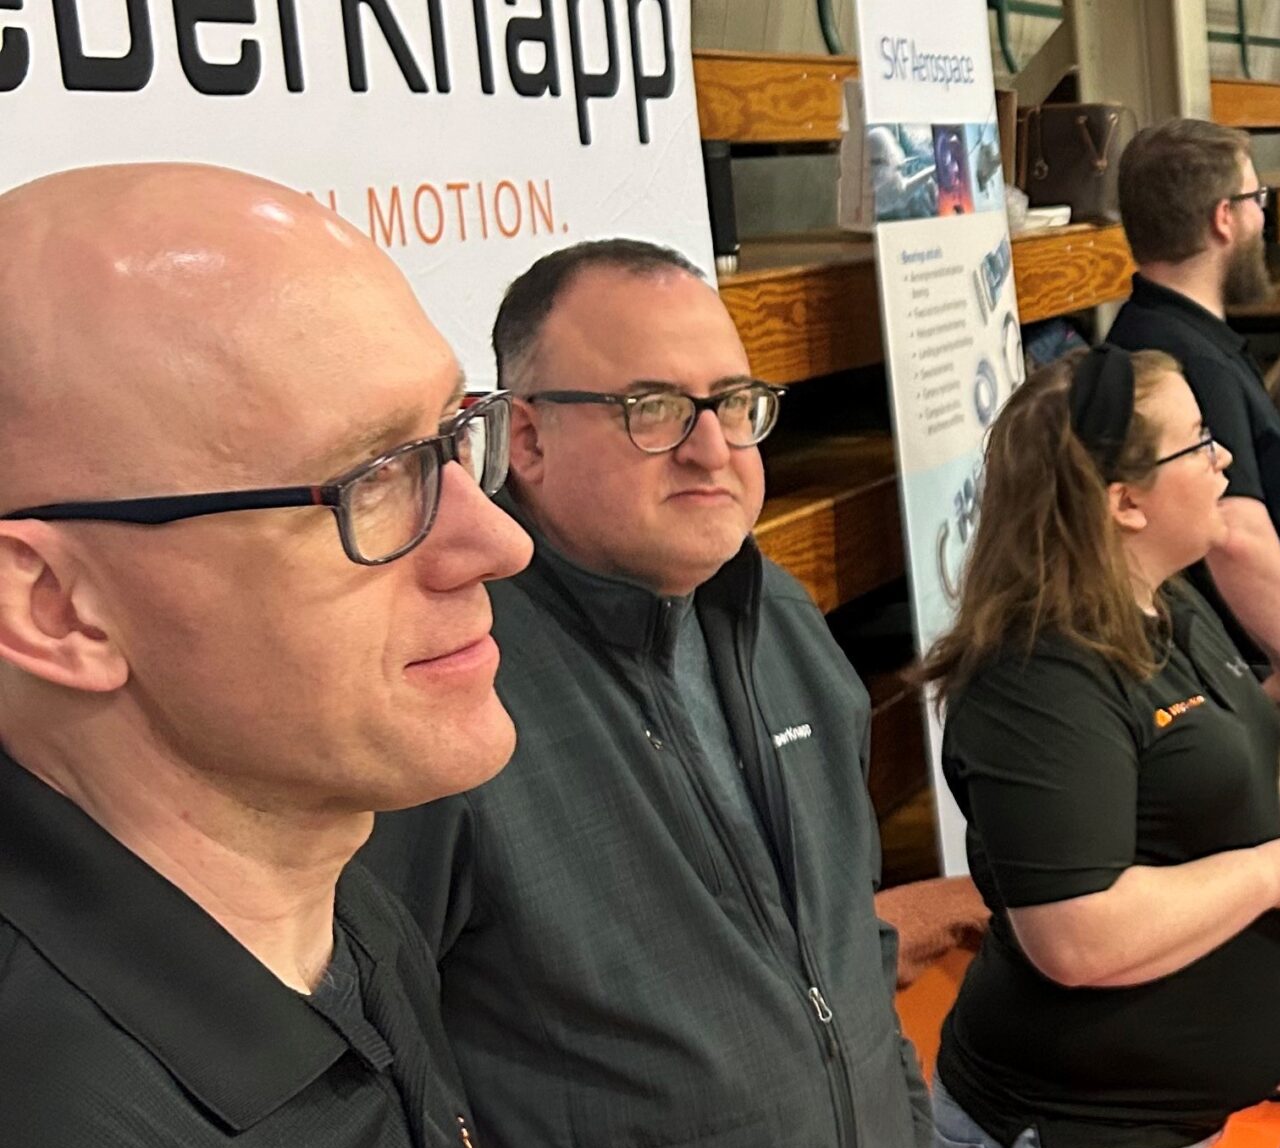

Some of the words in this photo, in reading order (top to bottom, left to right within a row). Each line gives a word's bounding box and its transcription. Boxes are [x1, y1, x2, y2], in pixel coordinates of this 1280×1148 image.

[880, 35, 908, 81] SKF
[911, 39, 975, 91] Aerospace
[367, 179, 570, 247] MOTION.
